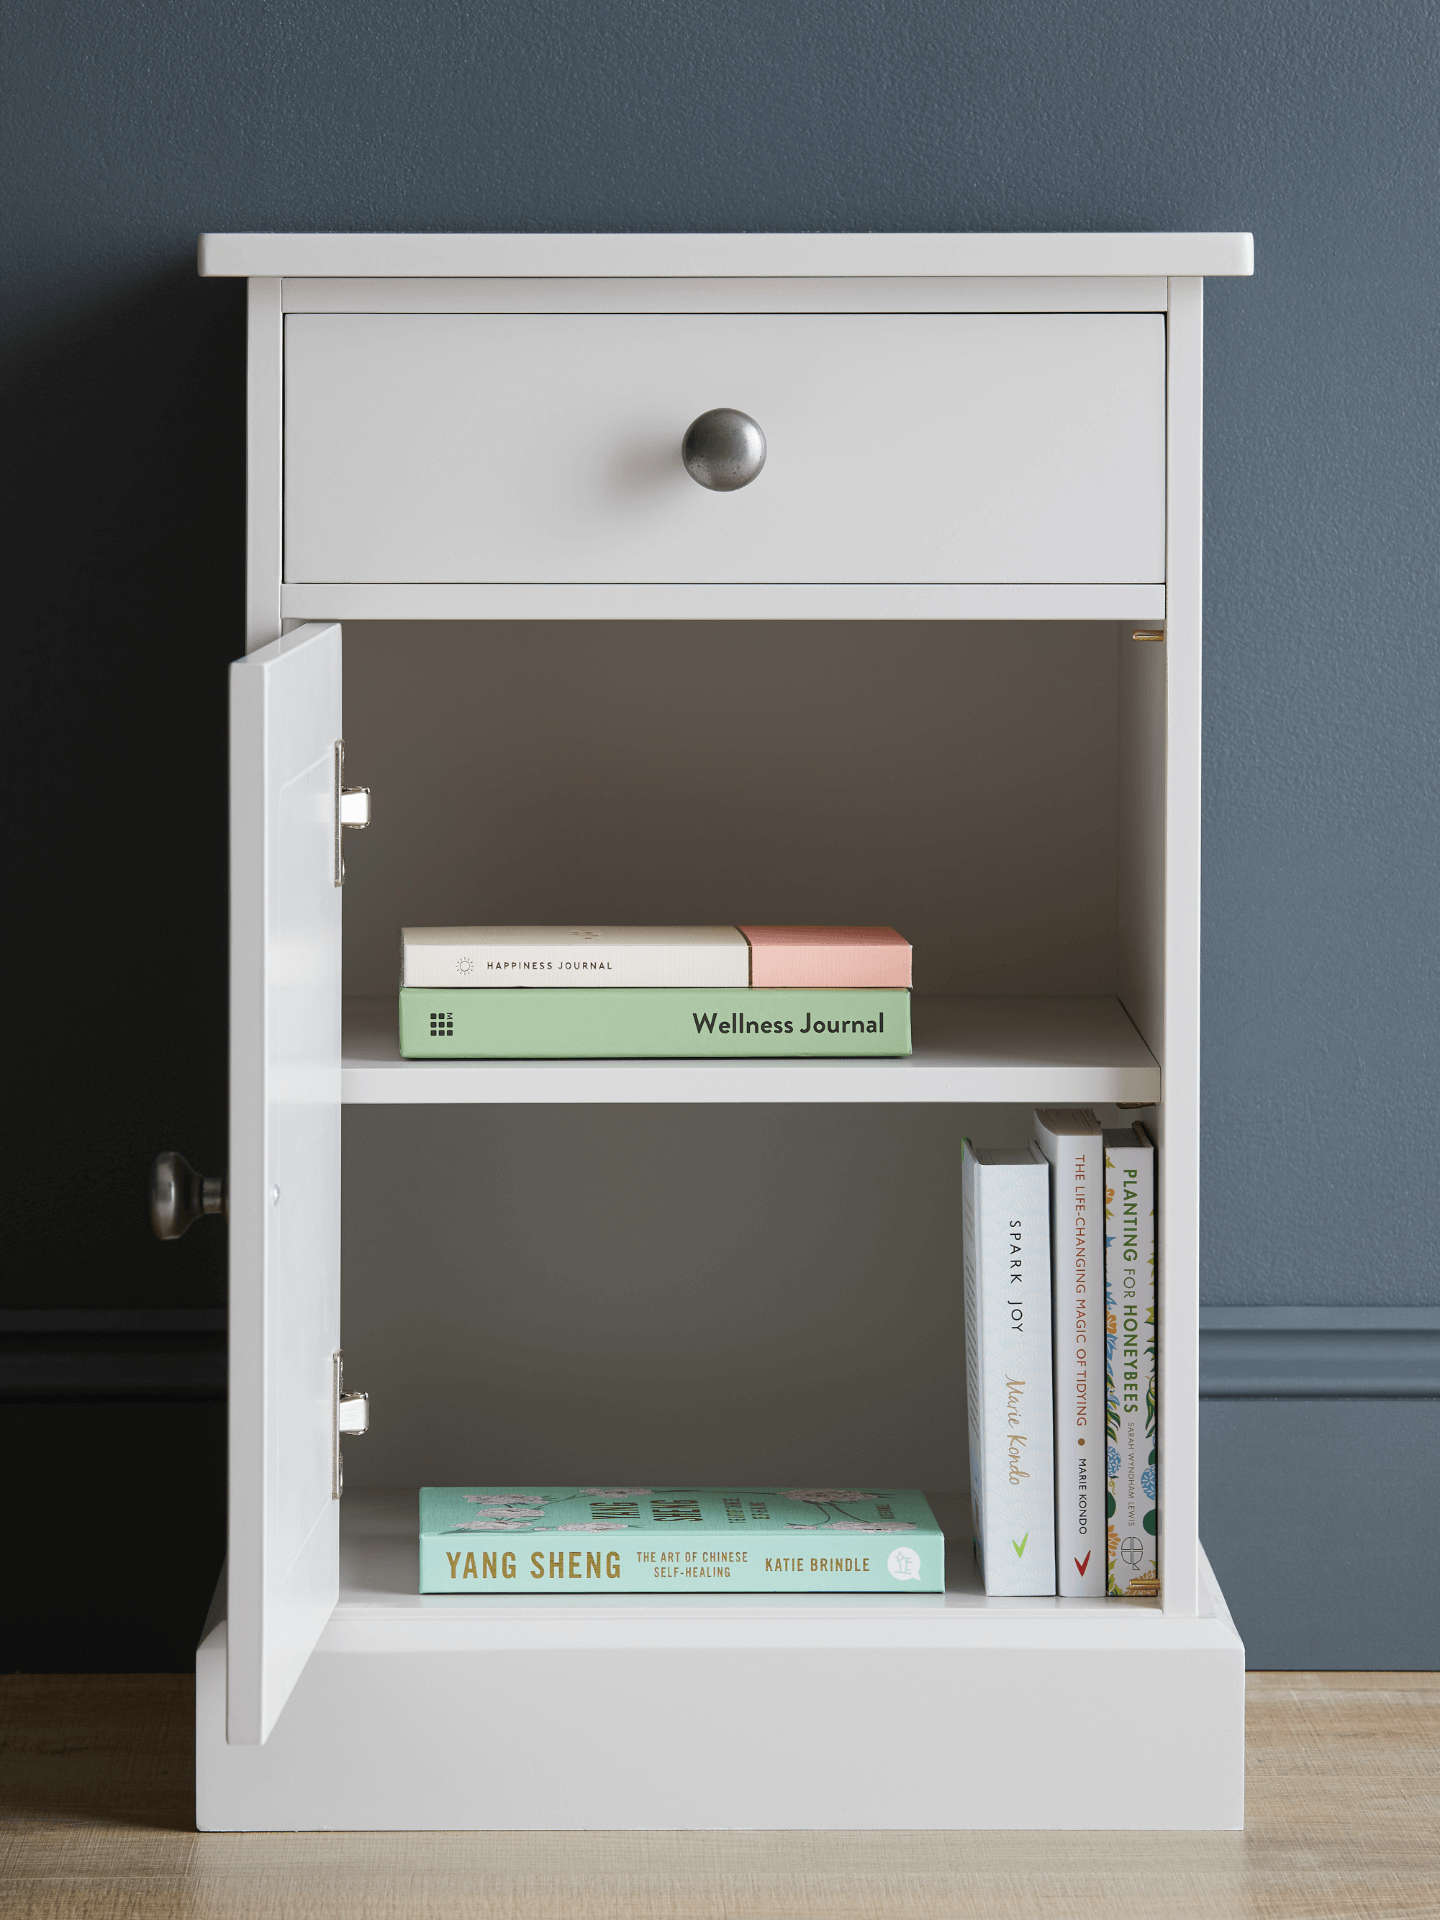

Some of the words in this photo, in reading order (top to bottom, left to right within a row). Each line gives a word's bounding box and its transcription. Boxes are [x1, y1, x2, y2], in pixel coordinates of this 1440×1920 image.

[487, 961, 553, 970] HAPPINESS
[557, 961, 613, 970] JOURNAL
[692, 1012, 794, 1034] Wellness
[799, 1012, 884, 1034] Journal
[1075, 1154, 1085, 1181] THE
[1123, 1169, 1138, 1262] PLANTING
[1009, 1220, 1022, 1284] SPARK
[1075, 1186, 1086, 1294] LIFE-CHANGING
[1123, 1268, 1136, 1299] FOR
[1007, 1300, 1024, 1333] JOY
[1076, 1299, 1087, 1344] MAGIC
[1076, 1348, 1087, 1367] OF
[1123, 1305, 1139, 1413] HONEYBEES
[1004, 1373, 1026, 1429] Marie
[1076, 1370, 1088, 1427] TIDYING
[1127, 1422, 1135, 1450] SARAH
[1006, 1434, 1031, 1486] Kondo
[1078, 1458, 1087, 1490] MARIE
[1127, 1452, 1136, 1499] WYNDHAM
[1078, 1494, 1088, 1535] KONDO
[1127, 1502, 1136, 1527] LEWIS
[445, 1551, 517, 1579] YANG
[530, 1551, 621, 1579] SHENG
[636, 1551, 657, 1563] THE
[660, 1551, 680, 1563] ART
[684, 1551, 698, 1563] OF
[702, 1551, 748, 1563] CHINESE
[653, 1566, 731, 1578] SELF-HEALING
[765, 1557, 804, 1572] KATIE
[810, 1557, 870, 1572] BRINDLE
